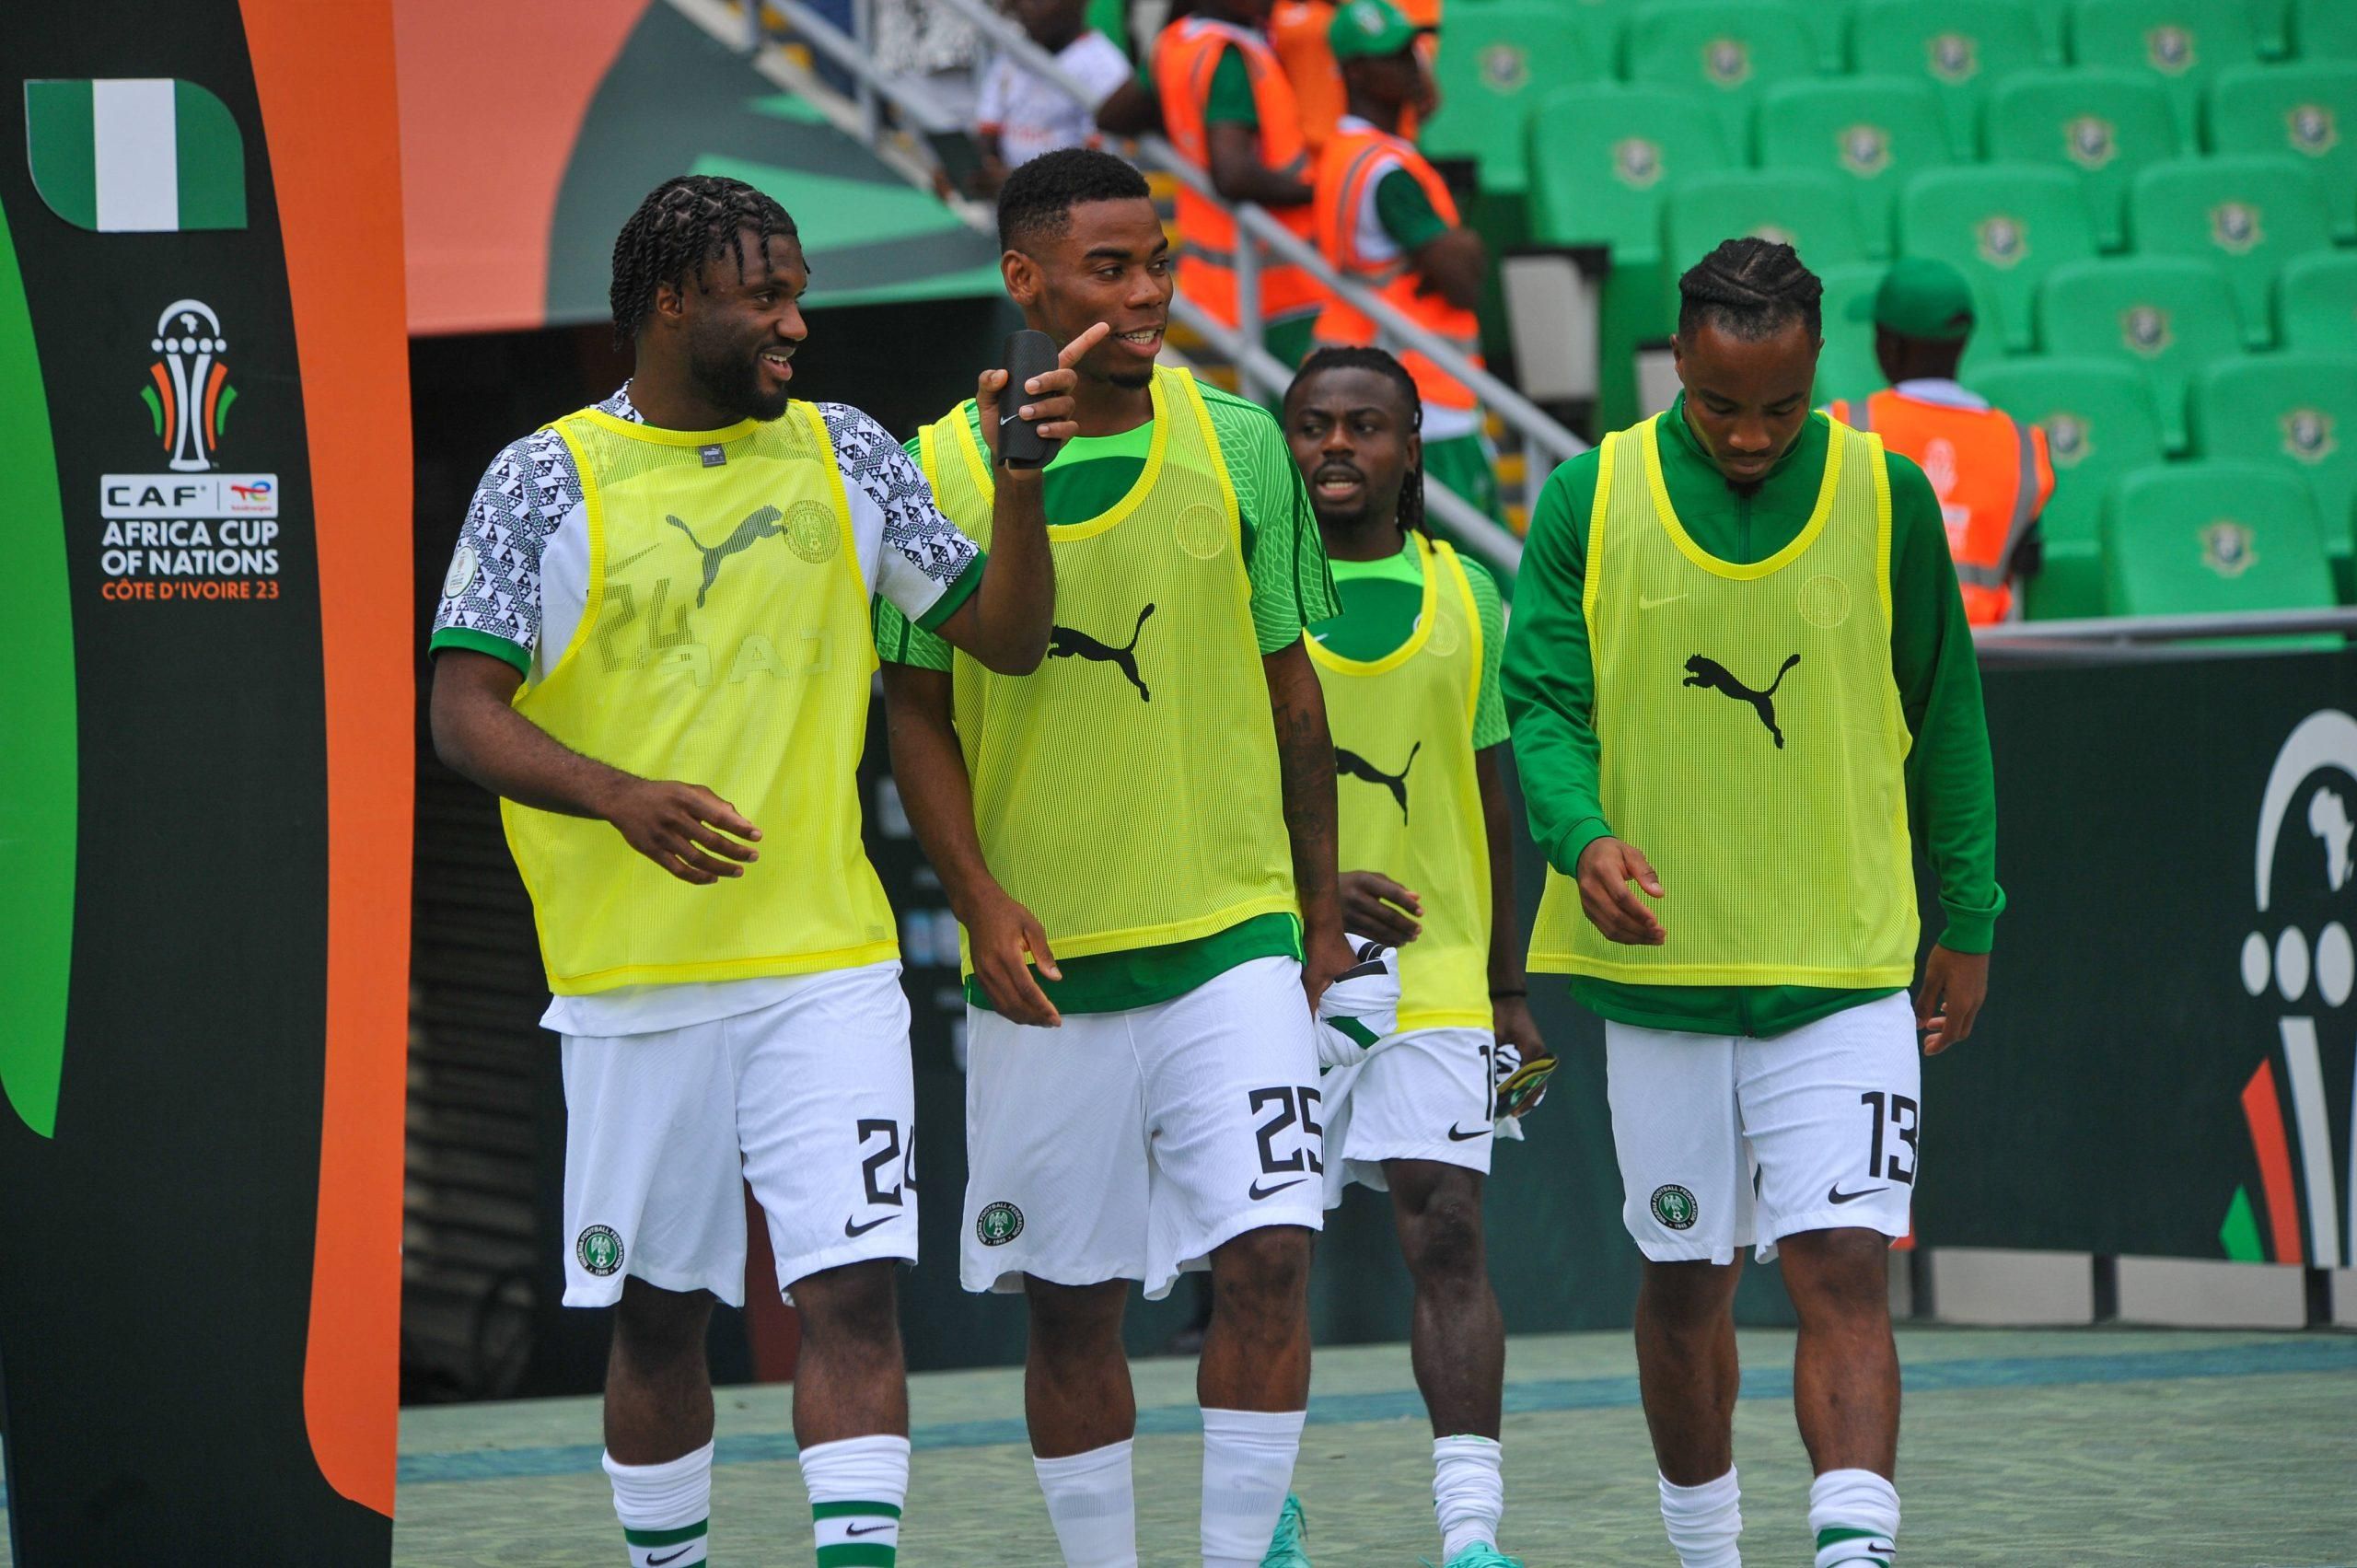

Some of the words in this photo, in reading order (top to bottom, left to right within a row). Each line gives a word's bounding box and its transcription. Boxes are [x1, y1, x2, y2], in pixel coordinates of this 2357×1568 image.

[108, 486, 196, 506] CAF
[102, 521, 212, 546] AFRICA
[219, 520, 279, 546] CUP
[101, 550, 143, 575] OF
[148, 549, 279, 576] NATIONS
[102, 578, 155, 600] CÔTE
[160, 582, 250, 599] D'IVOIRE
[256, 581, 280, 599] 23
[1479, 1045, 1494, 1121] 1
[1248, 1086, 1324, 1178] 25
[1861, 1091, 1918, 1186] 13
[1653, 1185, 1679, 1202] FOOTBALL
[979, 1202, 1008, 1222] FOOTBALL
[580, 1225, 610, 1241] FOOTBALL
